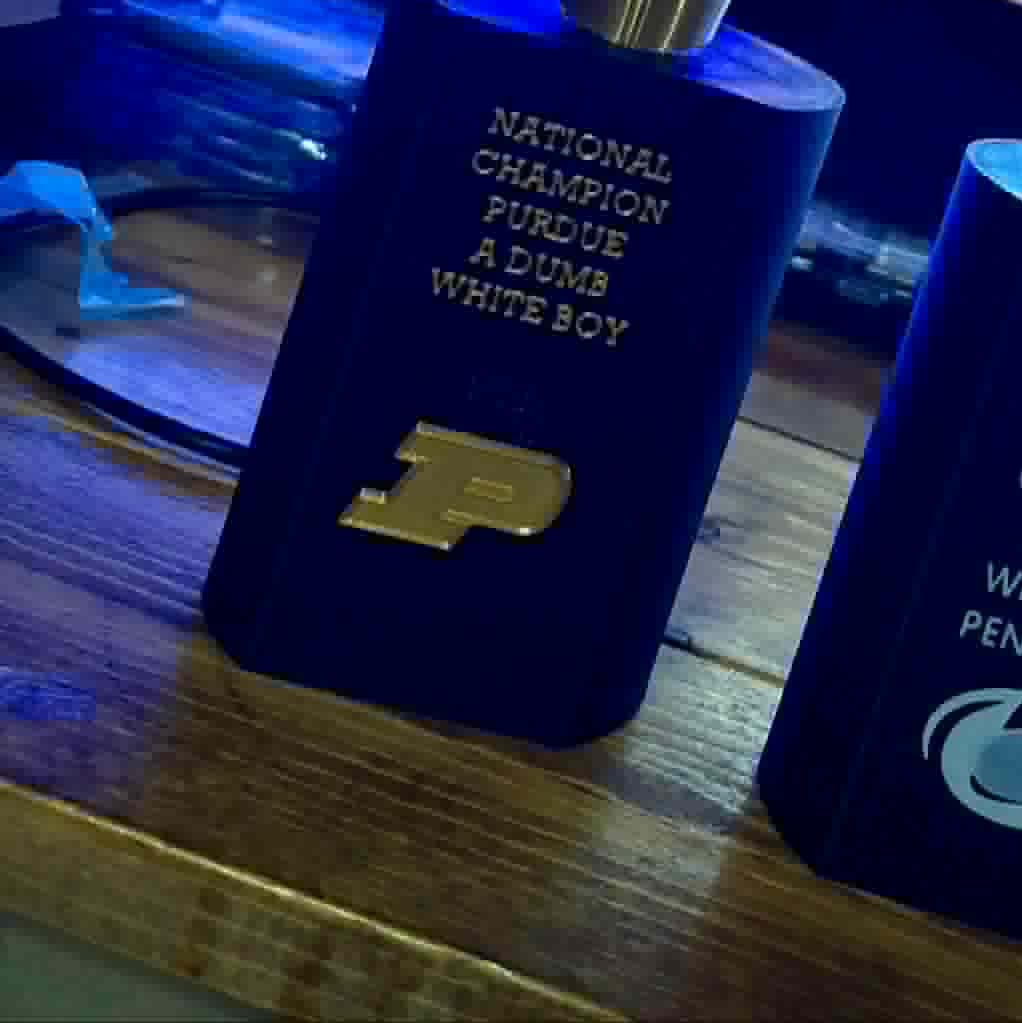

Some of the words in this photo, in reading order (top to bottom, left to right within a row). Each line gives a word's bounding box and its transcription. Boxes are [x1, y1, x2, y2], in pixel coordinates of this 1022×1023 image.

[488, 106, 672, 184] NATIONAL
[471, 148, 671, 224] CHAMPION
[481, 195, 630, 259] PURDUE
[464, 236, 497, 268] A
[504, 244, 609, 297] DUMB
[432, 267, 548, 325] WHITE
[551, 303, 631, 347] BOY
